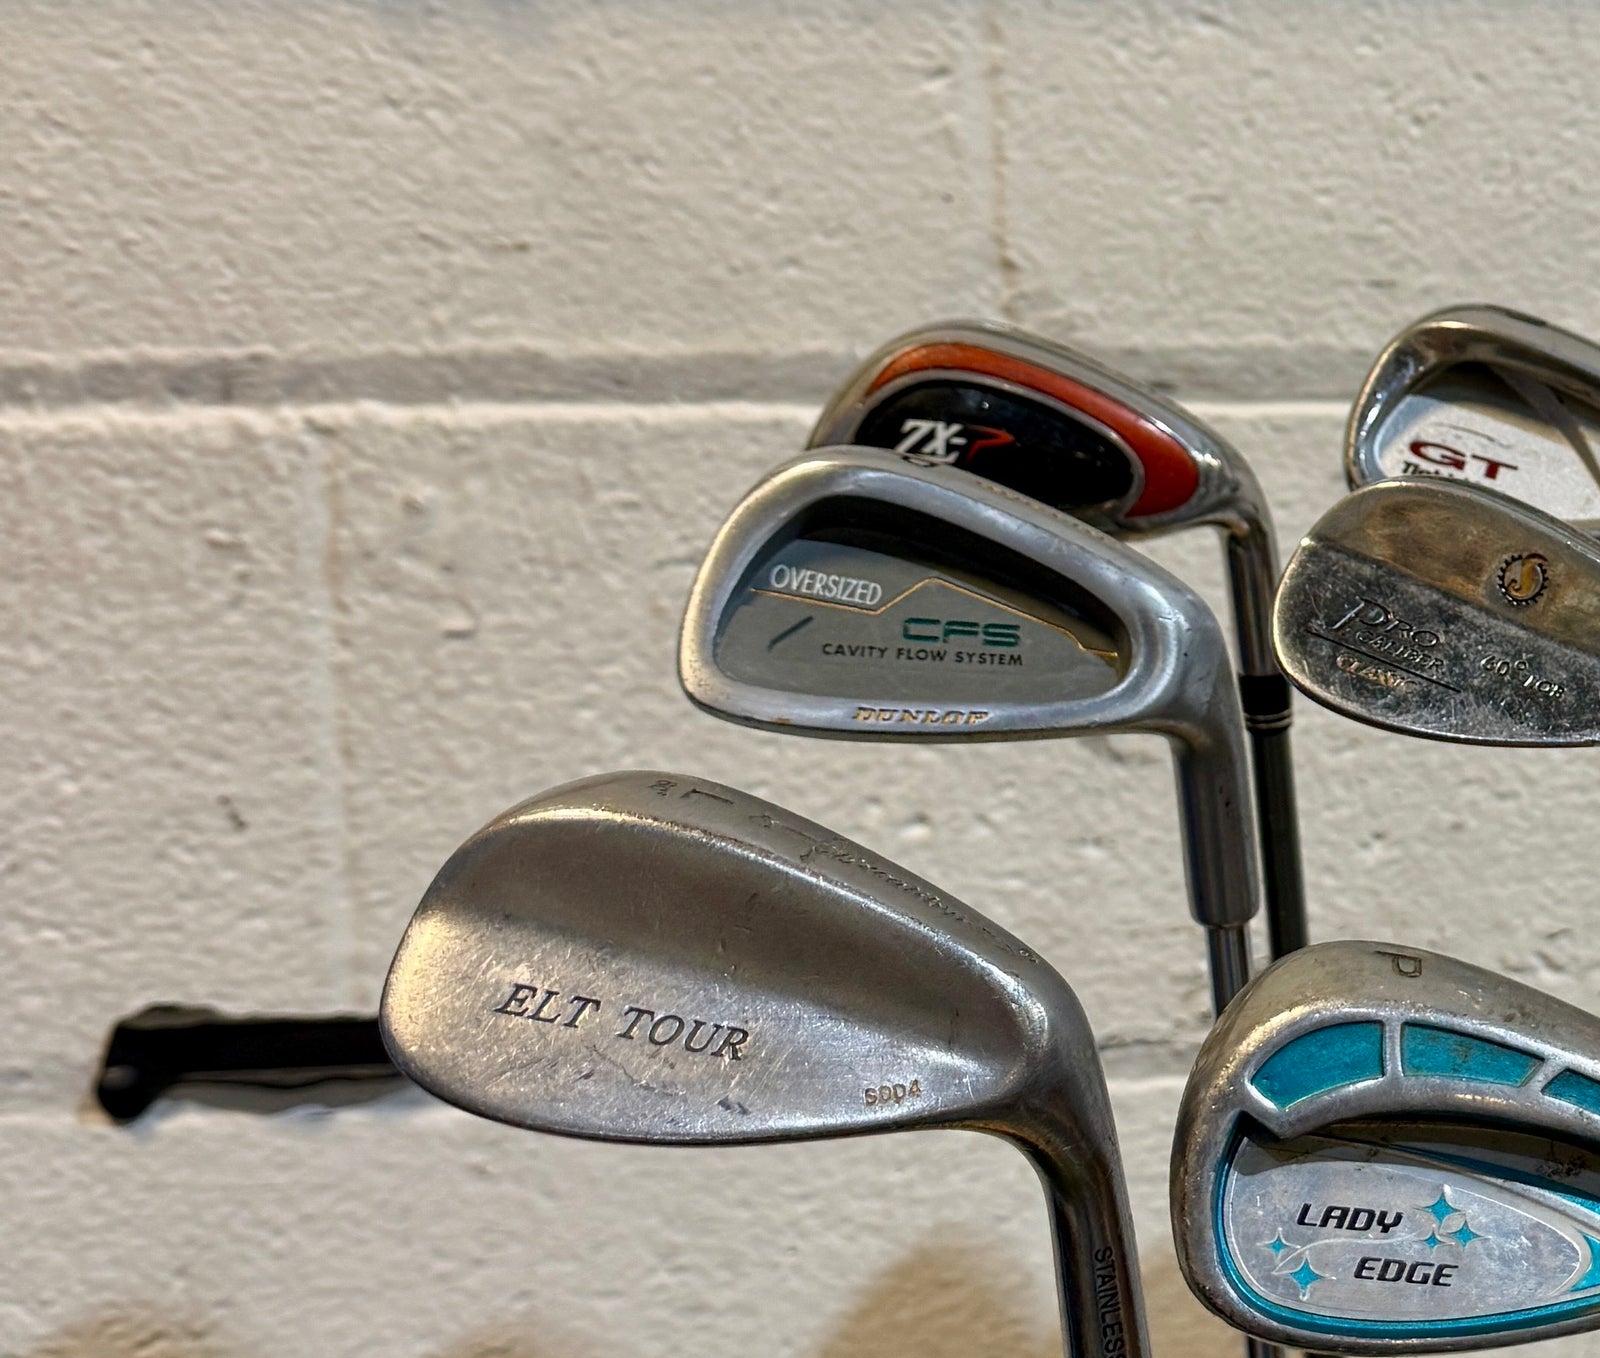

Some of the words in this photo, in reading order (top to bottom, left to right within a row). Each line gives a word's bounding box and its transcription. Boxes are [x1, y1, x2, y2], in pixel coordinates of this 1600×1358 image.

[1409, 441, 1518, 480] GT
[770, 564, 882, 606] OVERSIZED
[902, 617, 1021, 648] CFS
[821, 642, 888, 660] CAVITY
[895, 648, 948, 662] FLOW
[954, 653, 1024, 667] SYSTEM
[852, 706, 992, 727] DUNLOP
[1375, 950, 1422, 979] P
[493, 983, 601, 1028] ELT
[616, 1004, 750, 1061] TOUR
[1296, 1203, 1404, 1234] LADY
[1353, 1256, 1459, 1287] EDGE
